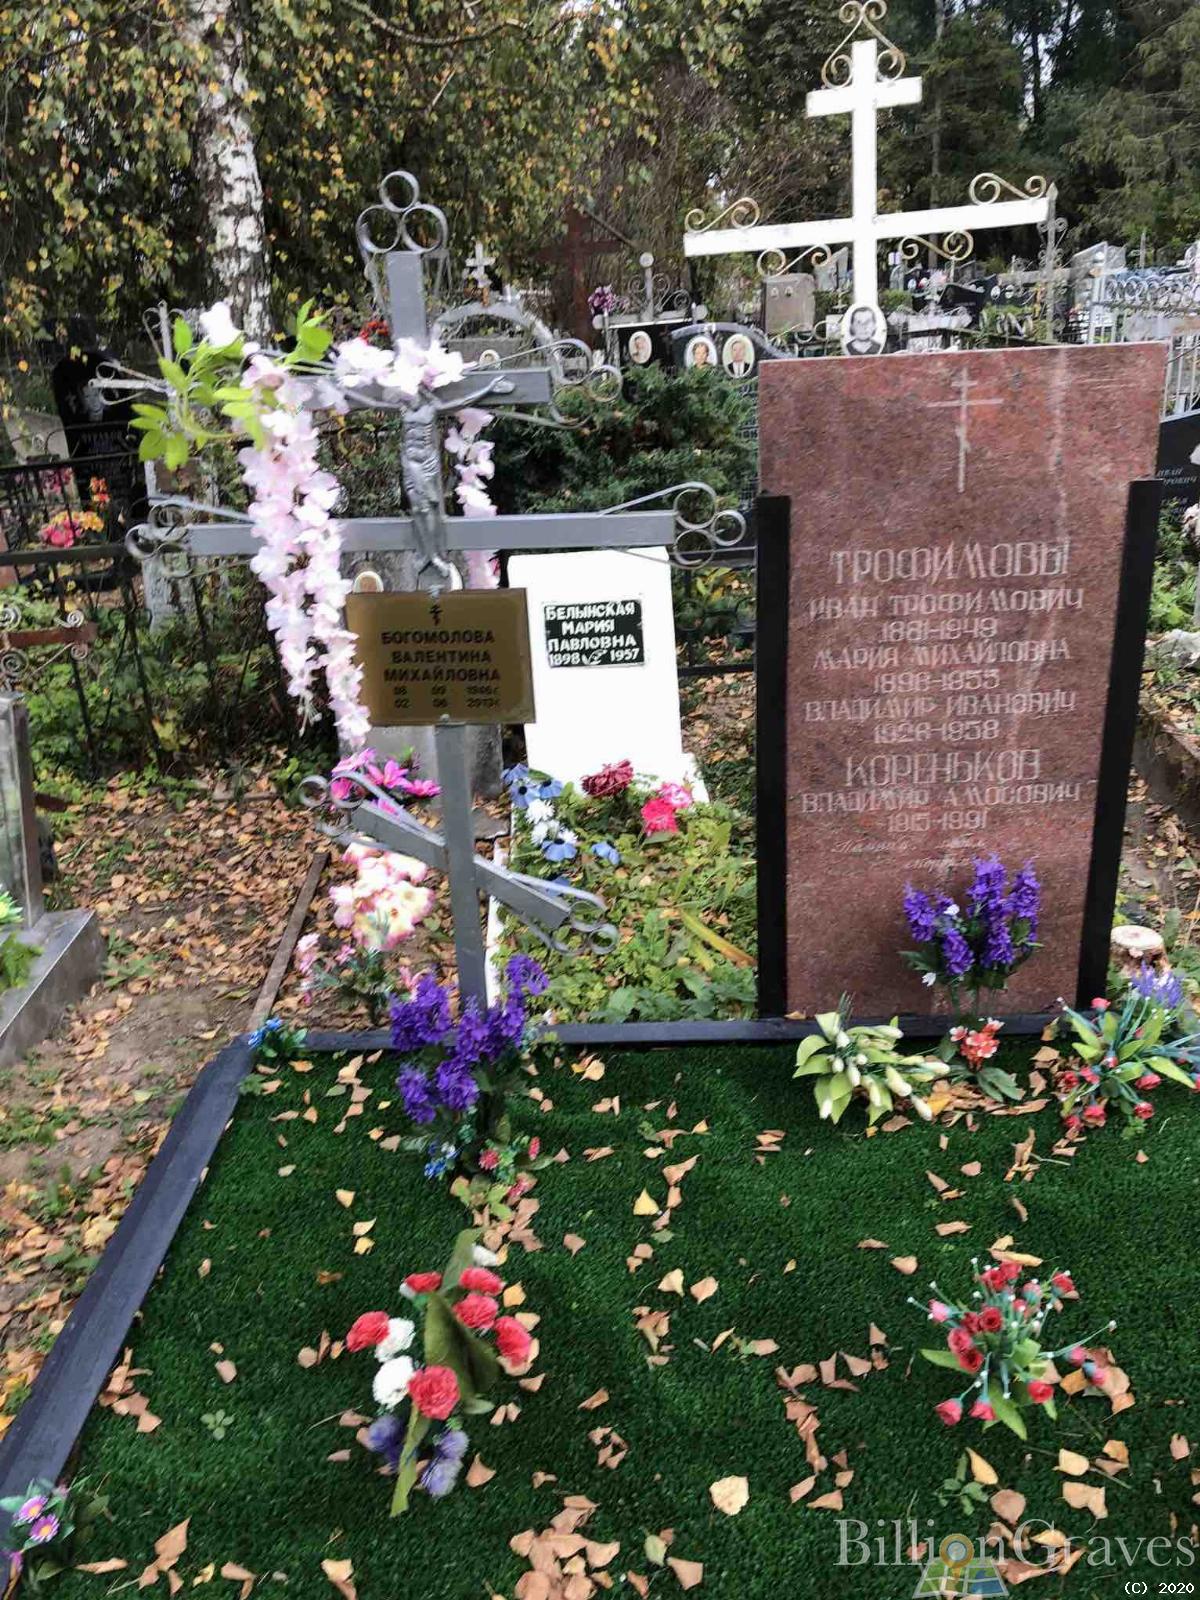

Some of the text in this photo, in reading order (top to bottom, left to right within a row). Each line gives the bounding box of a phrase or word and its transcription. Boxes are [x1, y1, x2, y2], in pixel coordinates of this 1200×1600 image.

[829, 538, 1072, 584] ТРОФИМОВЫ
[545, 601, 636, 620] БЕЛЫНСКАЯ
[808, 587, 1085, 620] ИВАН ТРОФИМОВИЧ
[381, 629, 495, 645] БОГОМОЛОВА
[561, 619, 615, 636] МАРИЯ
[547, 634, 637, 653] ПАВЛОВНА
[392, 649, 492, 664] ВАЛЕНТИНА
[549, 647, 640, 667] 1898 1957
[812, 638, 1072, 671] МАРИЯ МИХАЙЛОВНА
[383, 666, 500, 682] МИХАЙЛОВНА
[804, 688, 1077, 722] ВЛАДИМИР ИВАНОВИЧ
[845, 748, 1042, 787] КОРЕНЬКОВ
